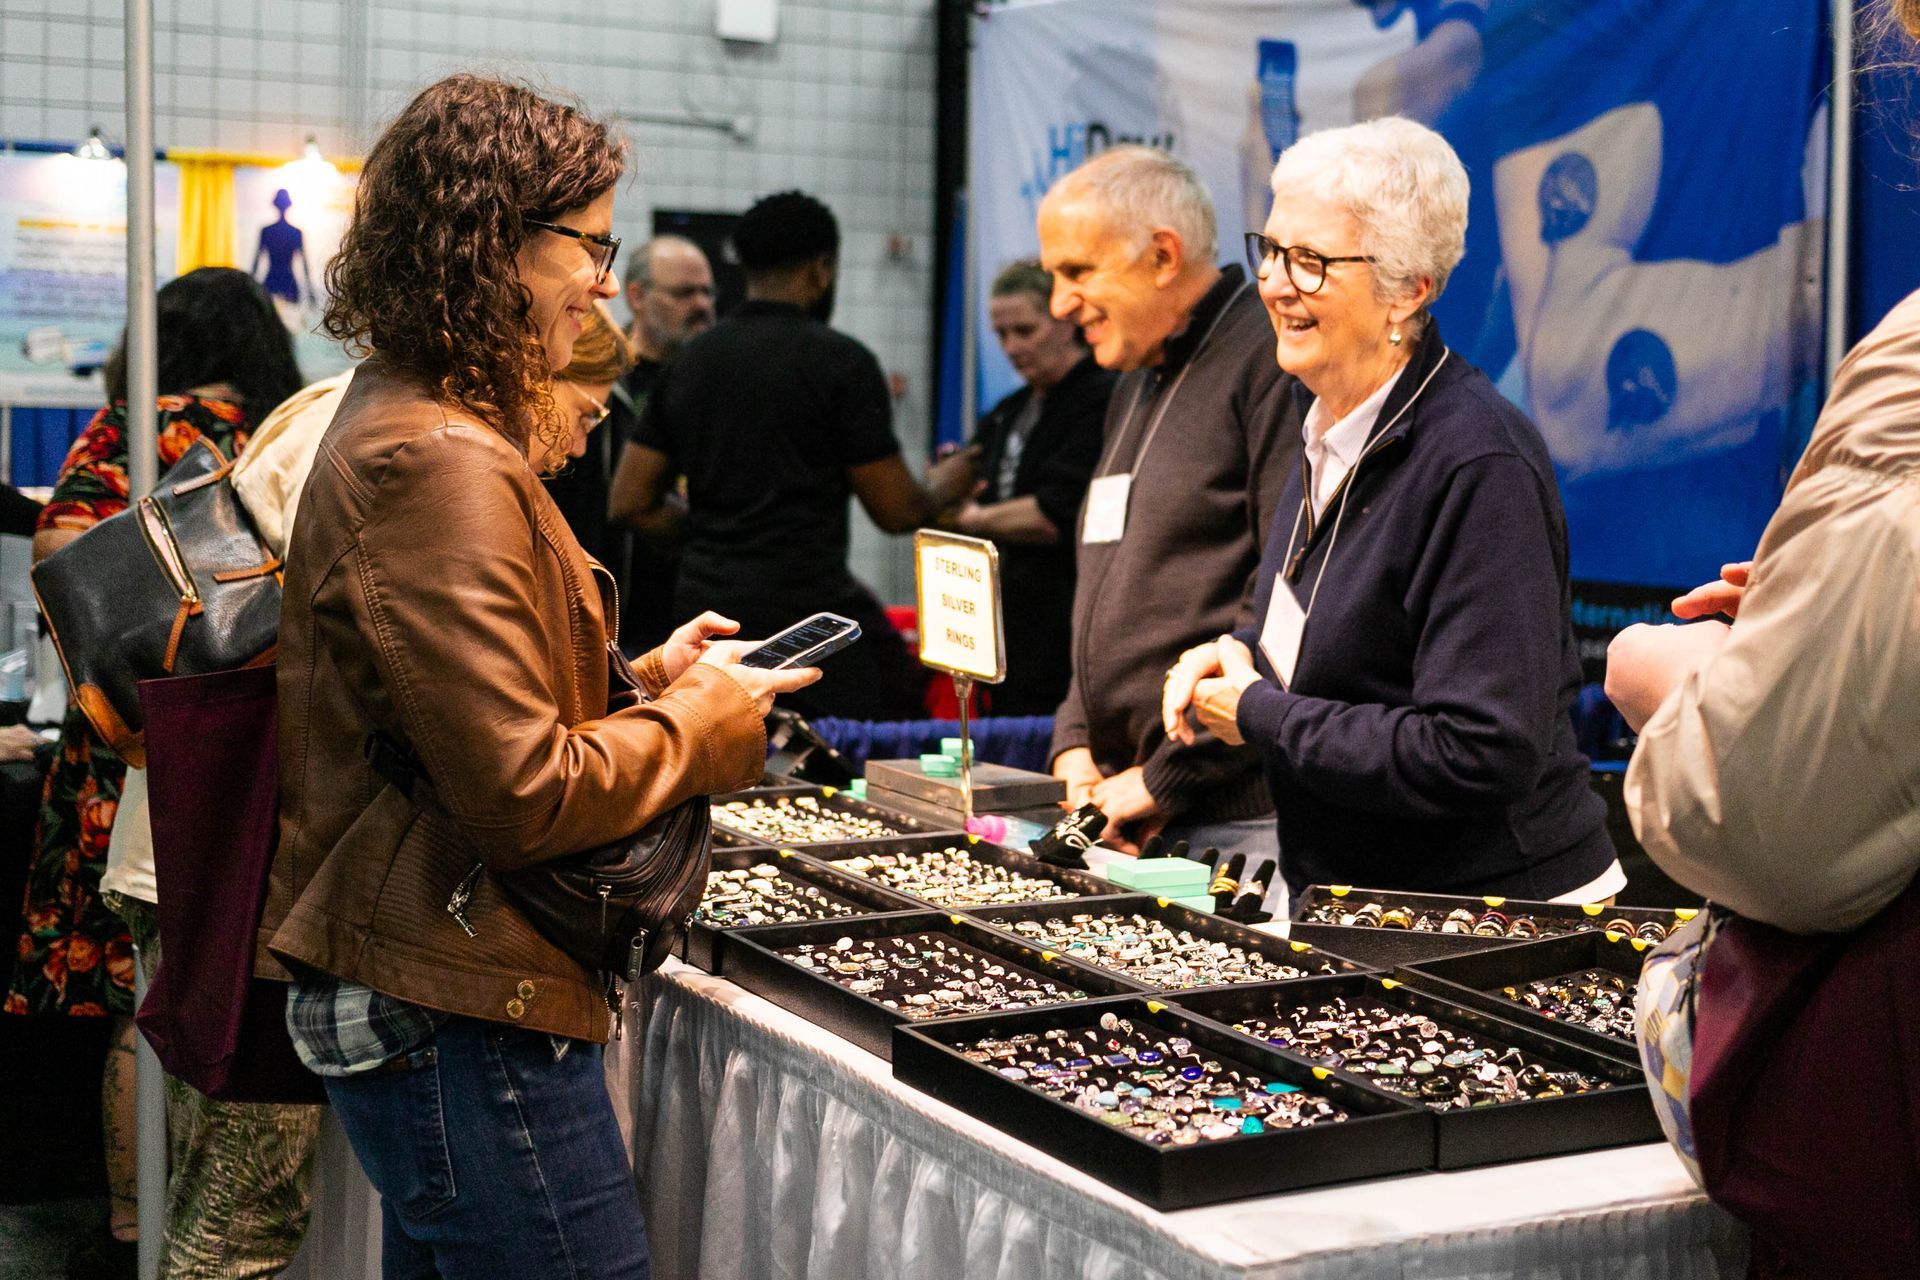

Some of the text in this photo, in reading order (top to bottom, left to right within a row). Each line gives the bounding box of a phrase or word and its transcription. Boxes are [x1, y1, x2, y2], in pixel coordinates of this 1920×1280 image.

[935, 557, 982, 582] STERLING
[942, 593, 975, 615] SILVER
[946, 628, 975, 650] RINGS
